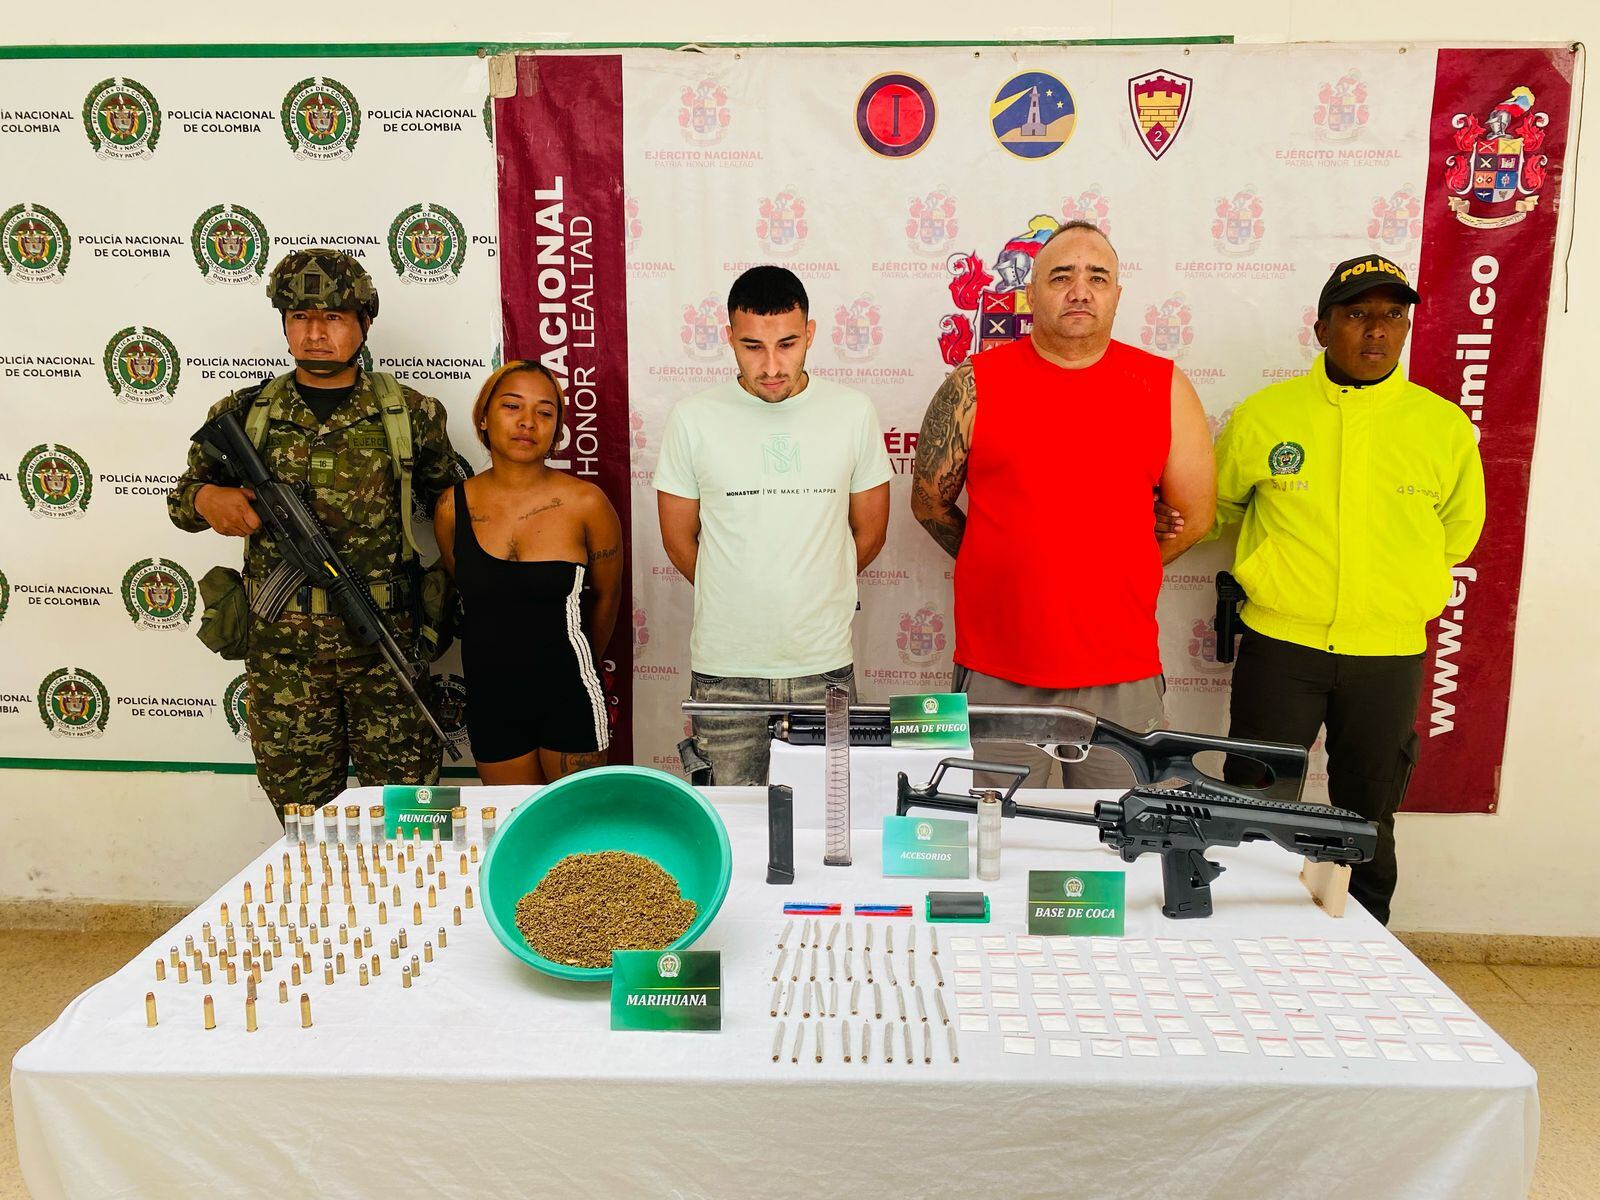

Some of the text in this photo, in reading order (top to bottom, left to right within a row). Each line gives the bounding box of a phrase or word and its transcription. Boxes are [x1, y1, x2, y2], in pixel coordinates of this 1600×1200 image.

[14, 110, 75, 120] NACIONAL
[167, 108, 276, 120] POLICÍA NACIONAL
[368, 108, 477, 119] POLICÍA NACIONAL
[0, 124, 60, 133] COLOMBIA
[184, 124, 261, 133] DE COLOMBIA
[384, 122, 462, 132] DE COLOMBIA
[1154, 131, 1162, 142] 2
[704, 151, 763, 160] NACIONAL
[1338, 150, 1401, 159] NACIONAL
[1285, 160, 1390, 168] PATRIA HONOR LEALTAD
[78, 234, 185, 245] POLICÍA NACIONAL
[274, 234, 380, 245] POLICÍA NACIONAL
[472, 236, 498, 244] POLI
[94, 248, 171, 258] DE COLOMBIA
[488, 248, 498, 257] D
[626, 262, 676, 271] ACIONAL
[1236, 262, 1297, 272] NACIONAL
[881, 272, 942, 280] PATRIA HONOR
[1184, 272, 1286, 280] PATRIA HONOR LEALTAD
[570, 216, 599, 476] HONOR LEALTAD
[0, 354, 96, 366] OLICÍA NACIONAL
[186, 356, 290, 367] POLICÍA NACIONAL
[380, 356, 486, 368] POLICÍA NACIONAL
[6, 368, 82, 378] DE COLOMBIA
[202, 370, 276, 379] DE COLOMBIA
[395, 371, 472, 380] DE COLOMBIA
[856, 368, 914, 378] NACIONAL
[100, 473, 143, 484] POLICÍA
[115, 486, 129, 495] DE
[1164, 575, 1214, 584] ACIONAL
[14, 584, 114, 595] POLICÍA NACIONAL
[28, 596, 101, 606] DE COLOMBIA
[634, 665, 680, 674] ACIONAL
[0, 694, 32, 703] IONAL
[117, 695, 217, 706] POLICÍA NACIONAL
[132, 708, 204, 718] DE COLOMBIA
[893, 724, 966, 734] ARMA DE FUEGO
[398, 812, 447, 824] MUNICIÓN
[900, 850, 952, 862] ACCESORIOS
[1035, 907, 1116, 918] BASE DE COCA
[626, 994, 707, 1006] MARIHUANA
